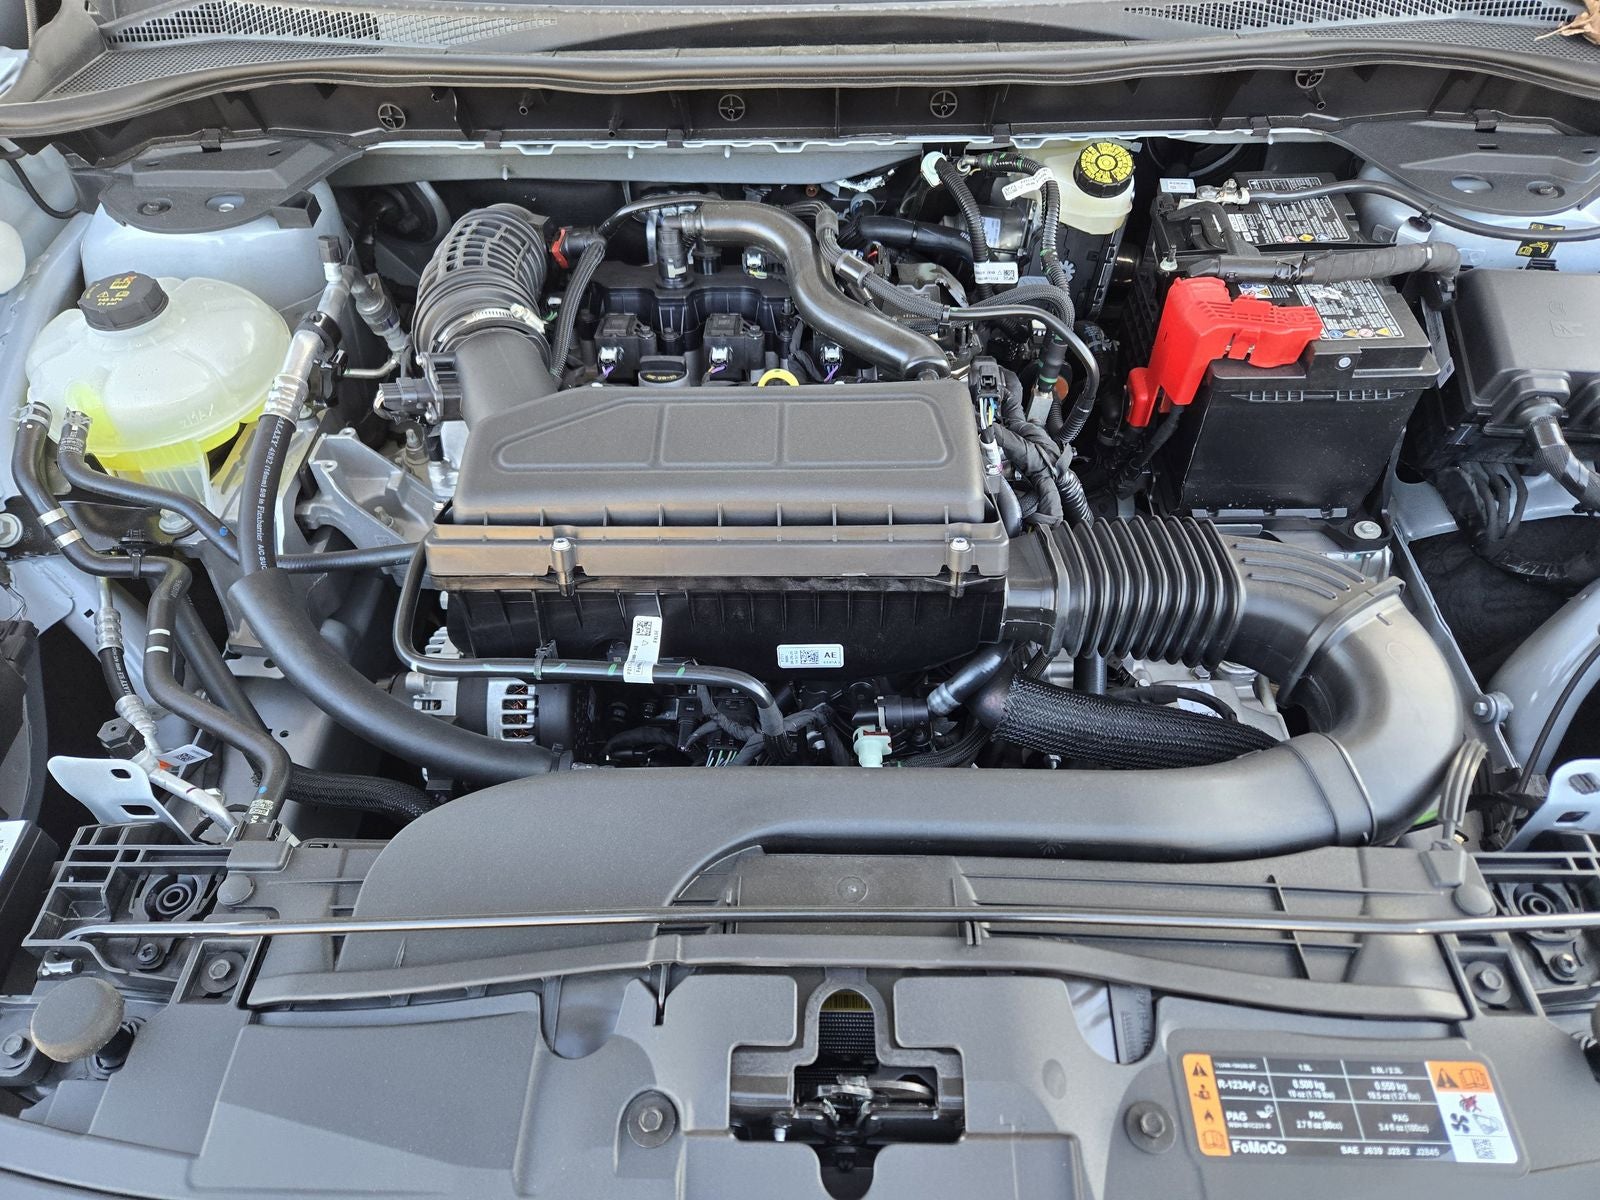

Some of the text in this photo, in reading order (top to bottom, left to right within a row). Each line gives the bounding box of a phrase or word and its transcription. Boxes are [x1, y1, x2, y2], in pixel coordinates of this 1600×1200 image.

[823, 651, 837, 659] AE
[1217, 1079, 1257, 1092] R-1234yf
[1314, 1079, 1326, 1092] kg
[1396, 1082, 1408, 1093] kg
[1226, 1111, 1248, 1121] PAG
[1308, 1111, 1326, 1120] PAG
[1391, 1113, 1409, 1122] PAG
[1231, 1140, 1287, 1154] FoMoCo
[1340, 1145, 1360, 1155] SAE
